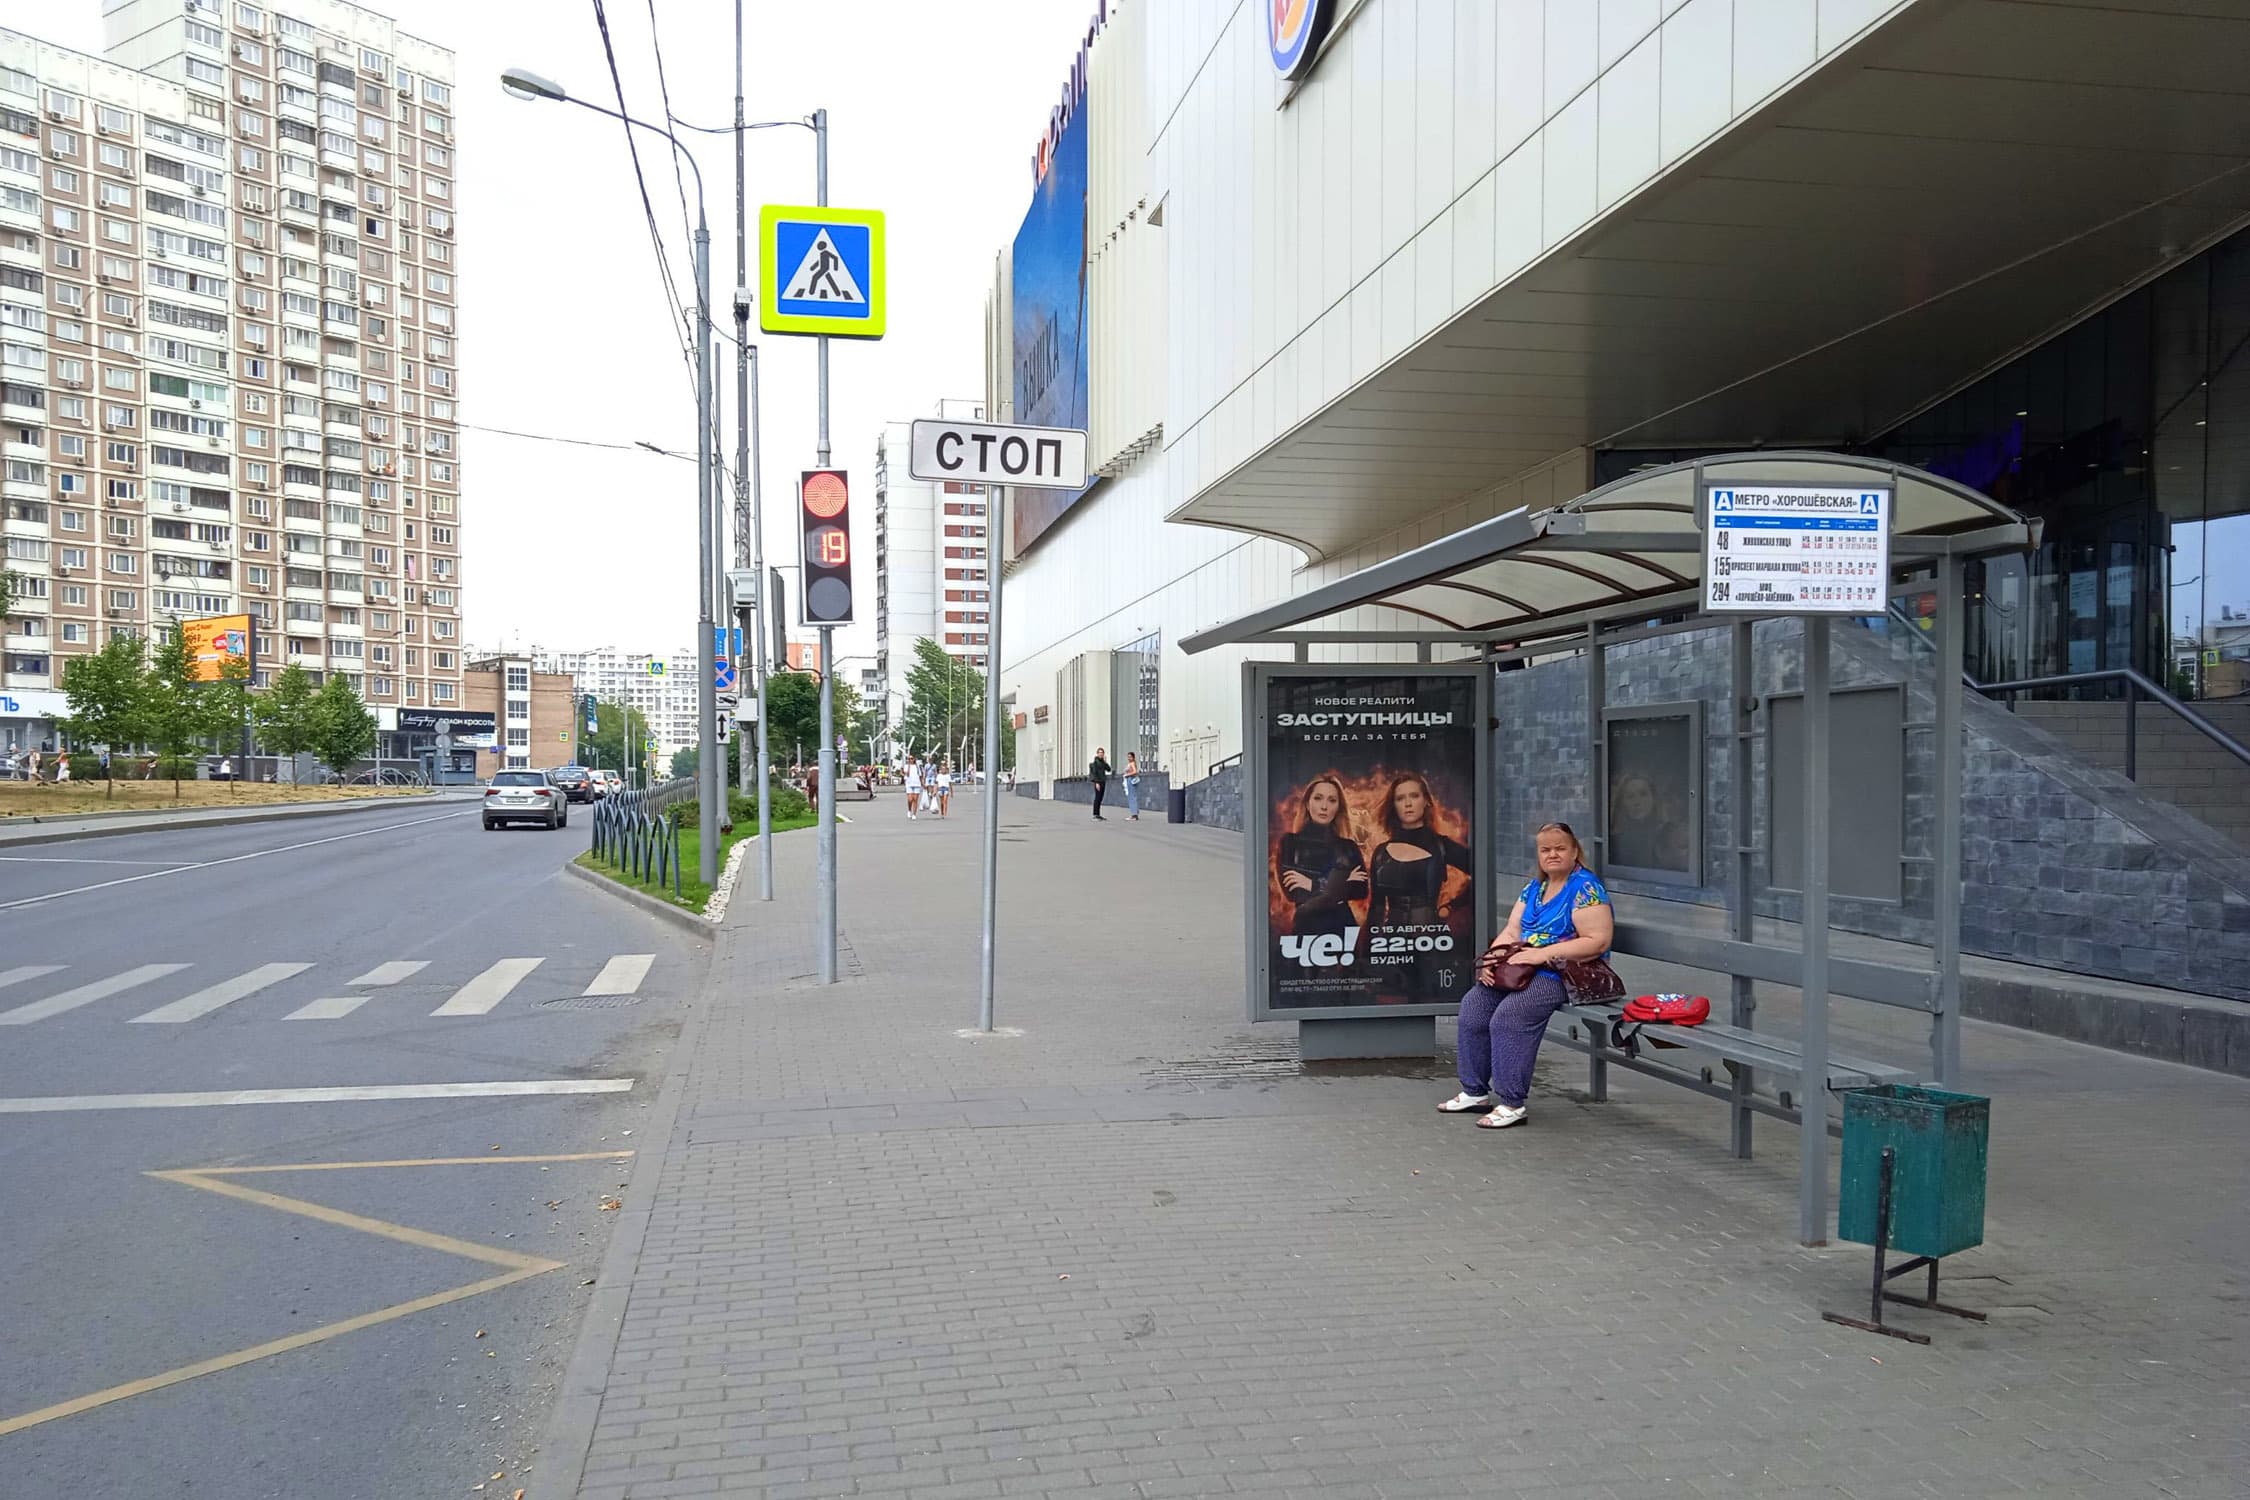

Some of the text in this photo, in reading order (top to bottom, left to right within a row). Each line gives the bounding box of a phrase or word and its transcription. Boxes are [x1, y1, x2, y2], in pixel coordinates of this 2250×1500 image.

[1023, 309, 1059, 420] ВЫШКА
[936, 431, 1062, 477] СТОП
[1735, 494, 1770, 505] МЕТРО
[1772, 494, 1857, 507] «ХОРОШЁВСКАЯ»
[822, 531, 846, 563] 19
[1717, 531, 1729, 550] 48
[1714, 556, 1731, 575] 155
[1712, 582, 1730, 601] 294
[1315, 697, 1415, 706] НОВОЕ РЕАЛИТИ
[1277, 712, 1452, 727] ЗАСТУПНИЦЫ
[1370, 926, 1380, 934] С
[1396, 924, 1451, 933] АВГУСТА
[1370, 935, 1454, 953] 22:00
[1370, 956, 1414, 965] БУДНИ
[1437, 968, 1457, 988] 16+
